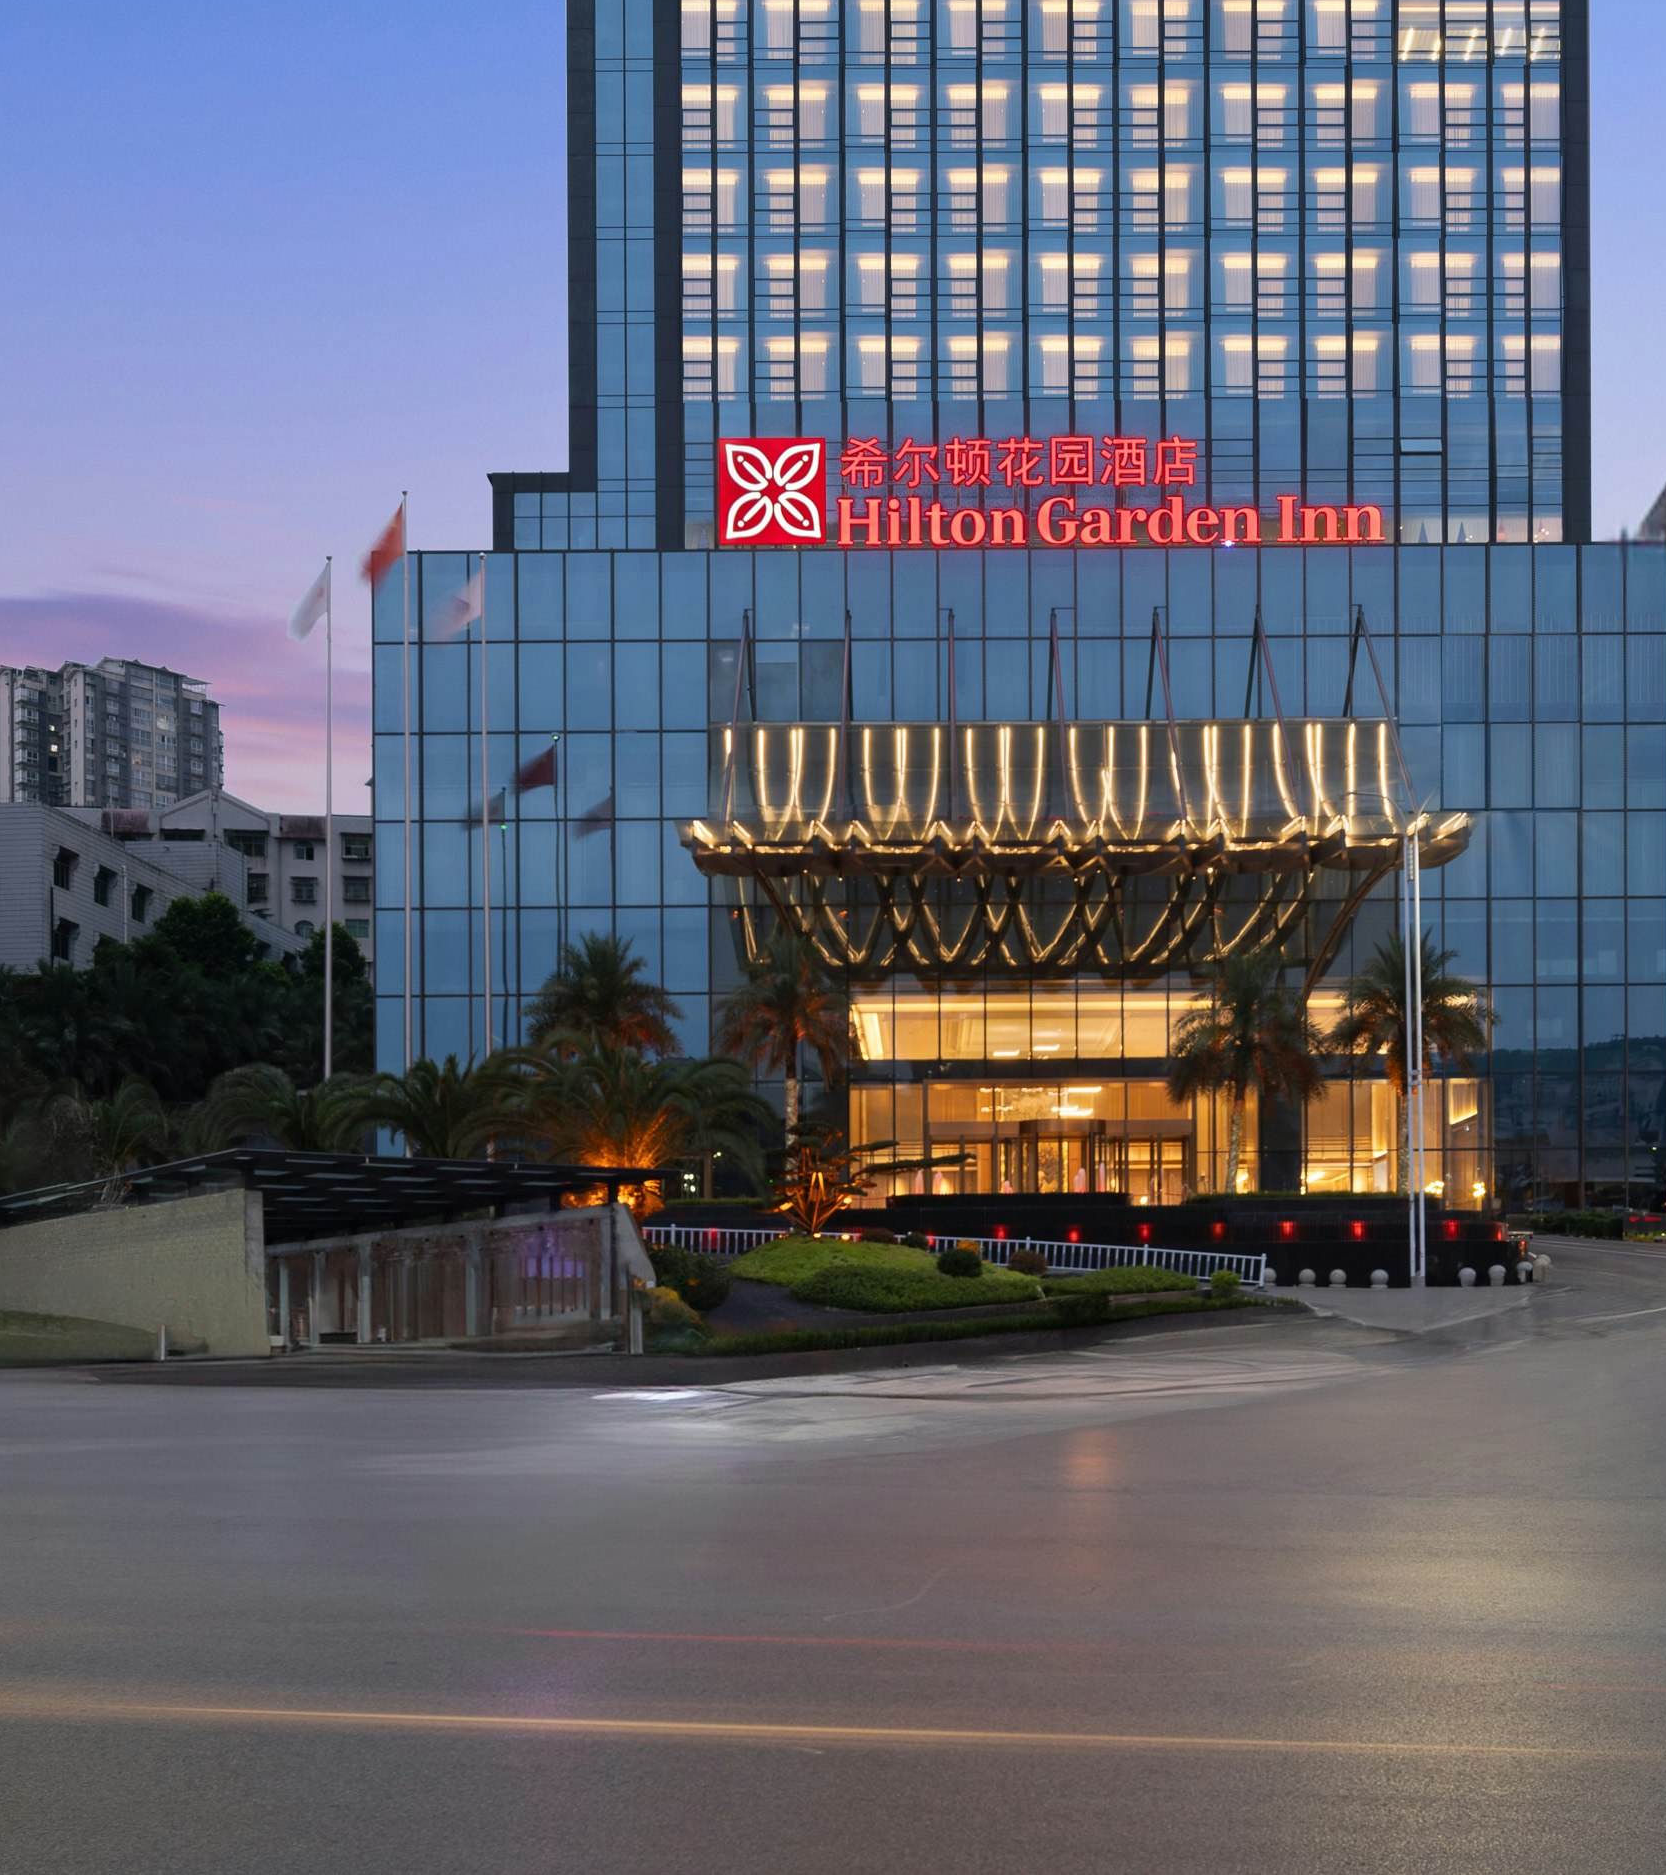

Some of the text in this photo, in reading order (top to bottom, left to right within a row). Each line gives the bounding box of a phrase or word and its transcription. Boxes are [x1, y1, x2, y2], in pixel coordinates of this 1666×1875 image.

[840, 435, 1198, 488] 希尔顿花园酒店
[836, 495, 1387, 546] Hilton Garden Inn
